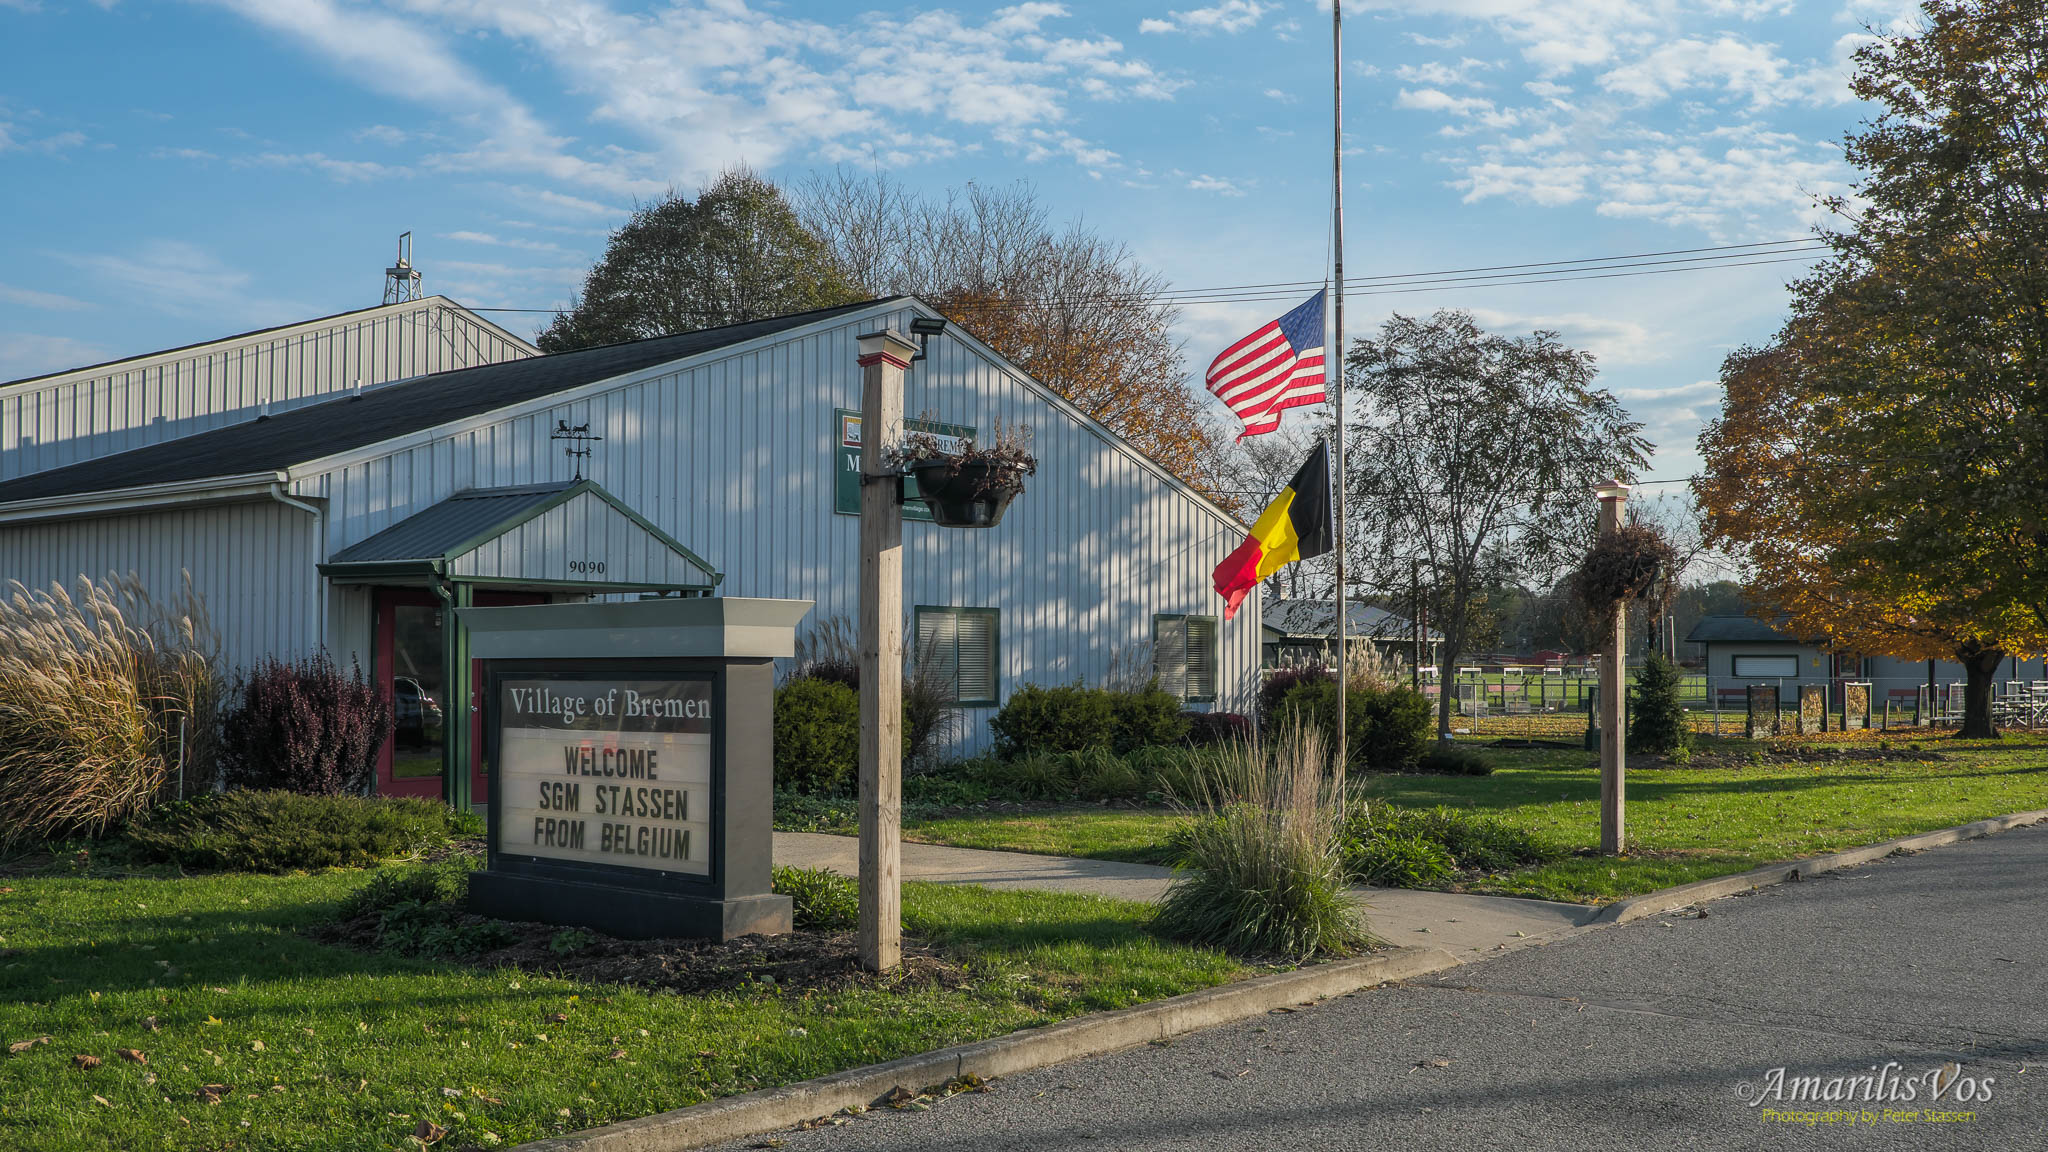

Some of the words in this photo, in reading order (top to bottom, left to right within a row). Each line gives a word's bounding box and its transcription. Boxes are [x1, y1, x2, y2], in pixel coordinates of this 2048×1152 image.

[569, 560, 605, 574] 9090
[510, 687, 586, 724] Village
[594, 688, 617, 716] of
[625, 689, 712, 719] Bremen
[564, 746, 658, 780] WELCOME
[539, 781, 580, 812] SGM
[595, 784, 688, 821] STASSEN
[534, 816, 585, 849] FROM
[601, 822, 690, 860] BELGIUM
